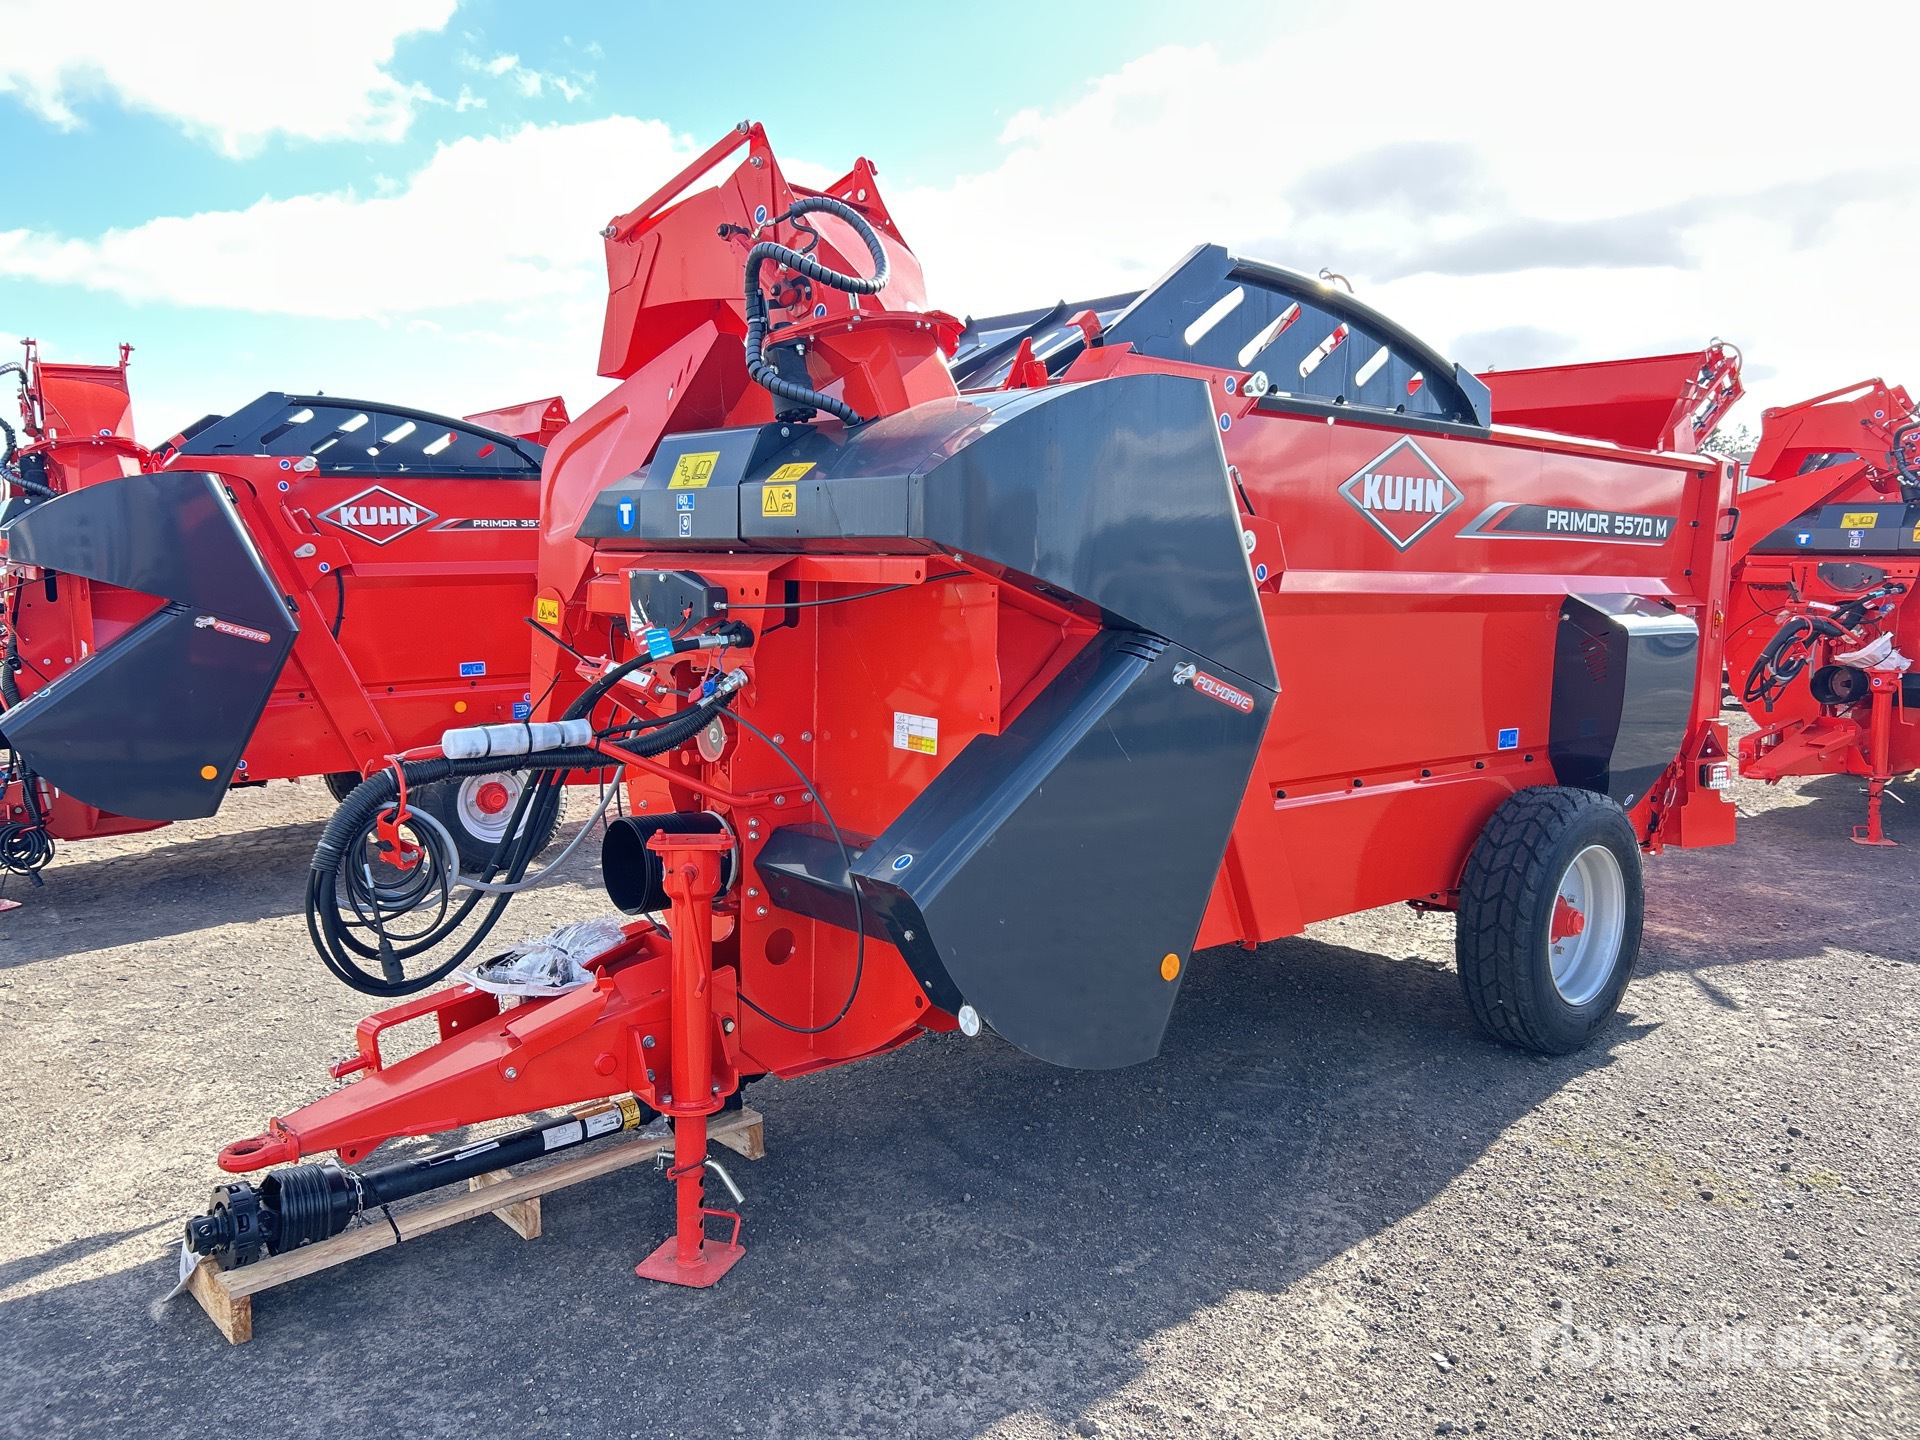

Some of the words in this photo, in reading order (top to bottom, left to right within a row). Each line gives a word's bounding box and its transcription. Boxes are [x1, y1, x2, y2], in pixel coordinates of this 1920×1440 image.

[678, 495, 688, 505] 60
[1363, 473, 1444, 513] KUHN
[340, 506, 418, 526] KUHN
[473, 519, 517, 528] PRIMOR
[620, 503, 632, 525] T
[1546, 509, 1610, 535] PRIMOR
[1614, 515, 1651, 536] 5570
[1655, 519, 1667, 538] M
[1798, 534, 1810, 544] T
[215, 622, 268, 641] POLYDRIVE
[1194, 675, 1252, 710] POLYDRIVE
